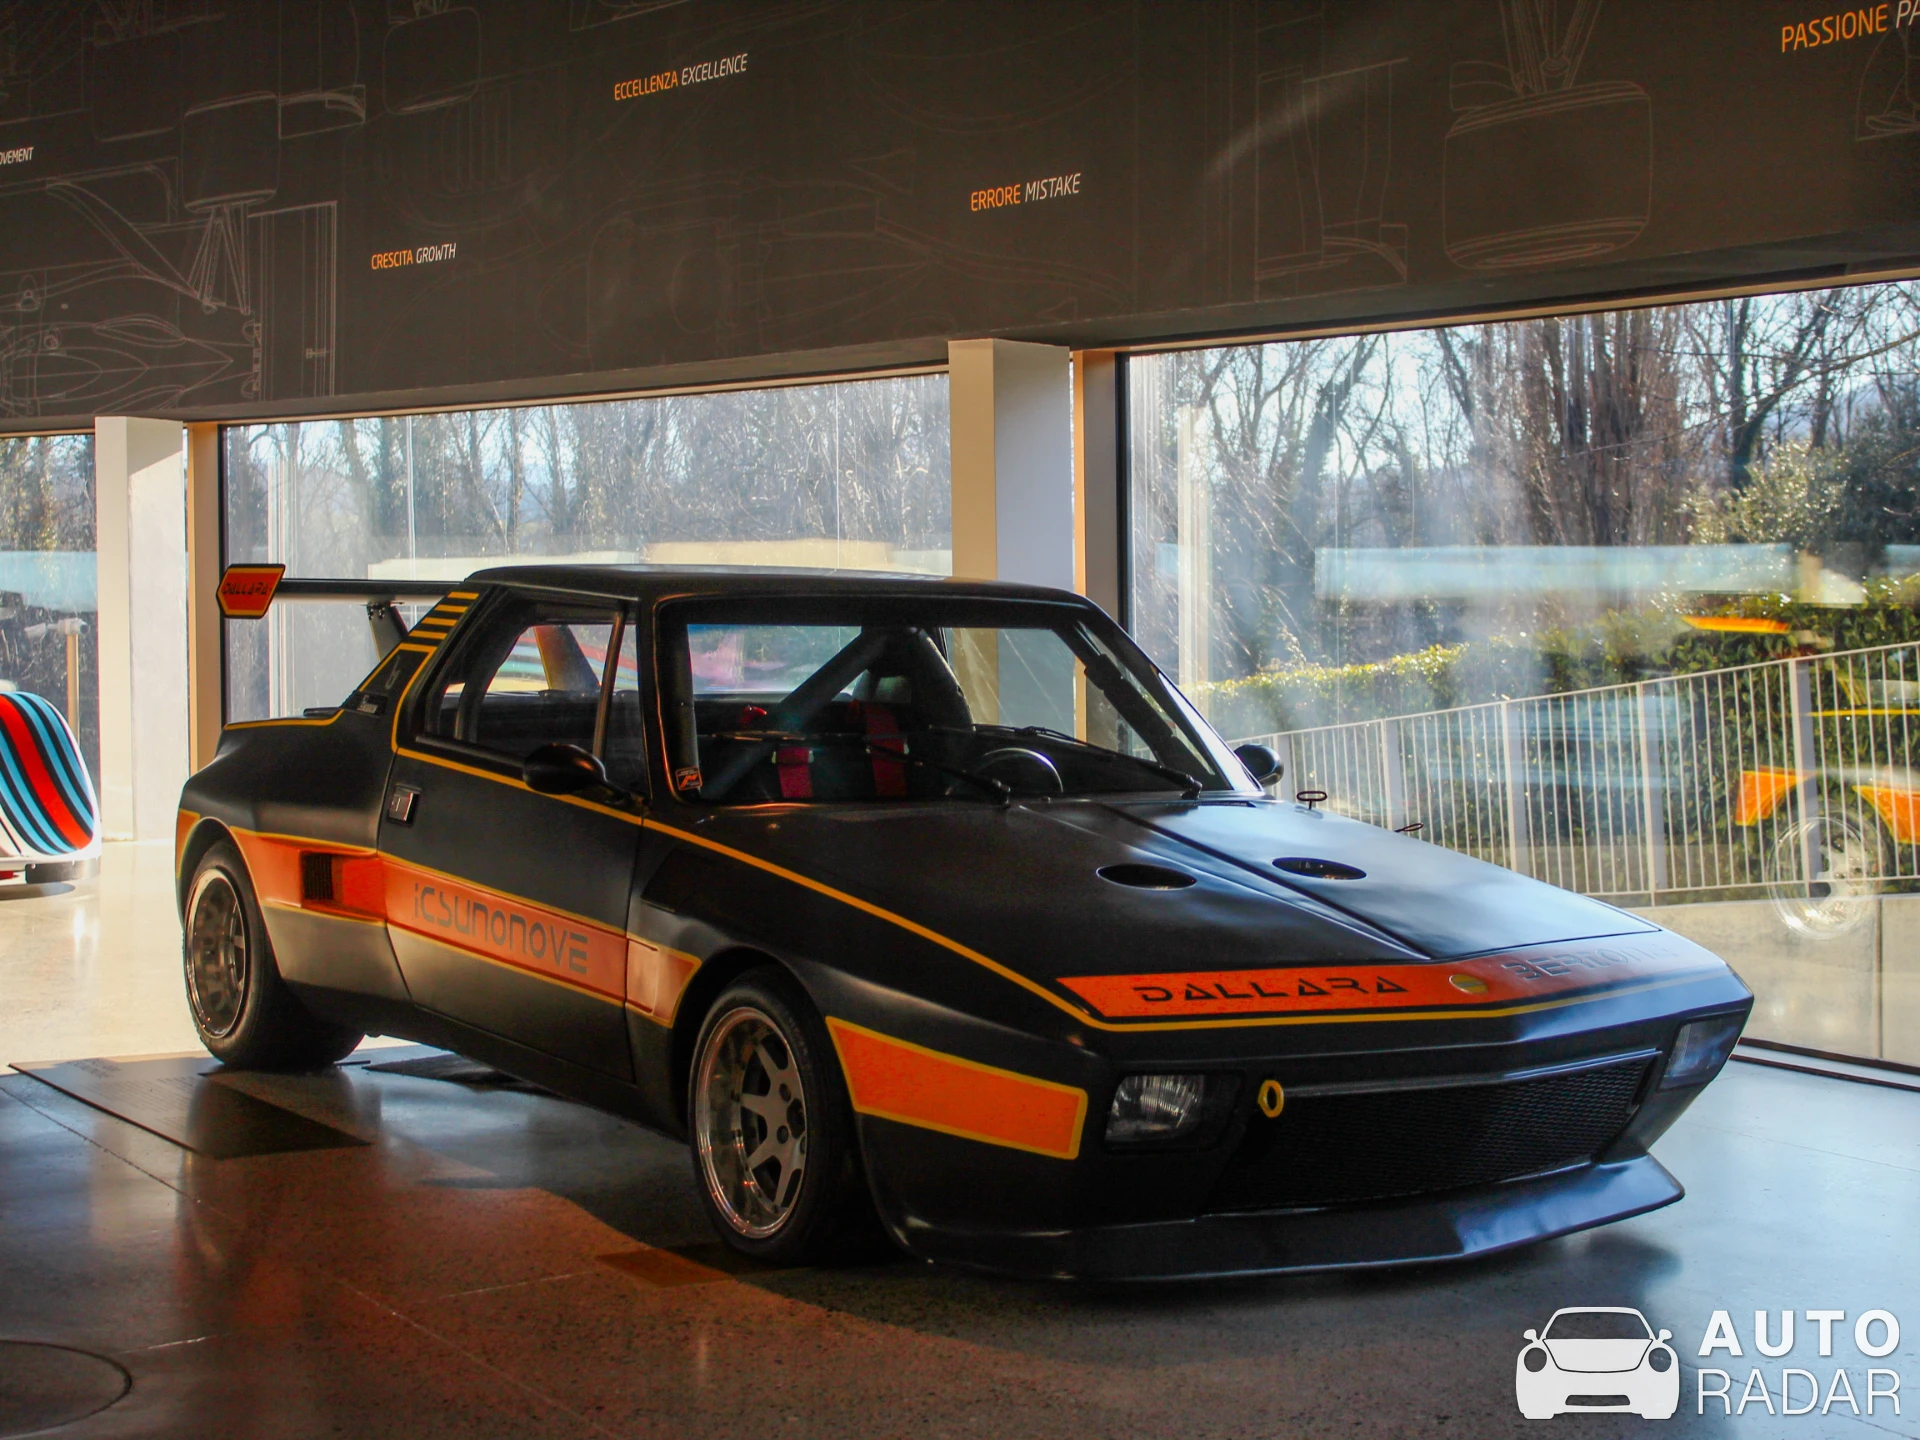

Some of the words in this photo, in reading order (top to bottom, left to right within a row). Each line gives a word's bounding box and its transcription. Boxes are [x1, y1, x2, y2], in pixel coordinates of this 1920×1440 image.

[1781, 3, 1888, 53] PASSIONE
[614, 70, 679, 101] ECCELLENZA
[681, 53, 748, 86] EXCELLENCE
[971, 183, 1021, 212] ERRORE
[1024, 173, 1081, 203] MISTAKE
[371, 249, 414, 270] CRESCITA
[415, 242, 457, 264] GROWTH
[1133, 976, 1408, 1002] DALLARA
